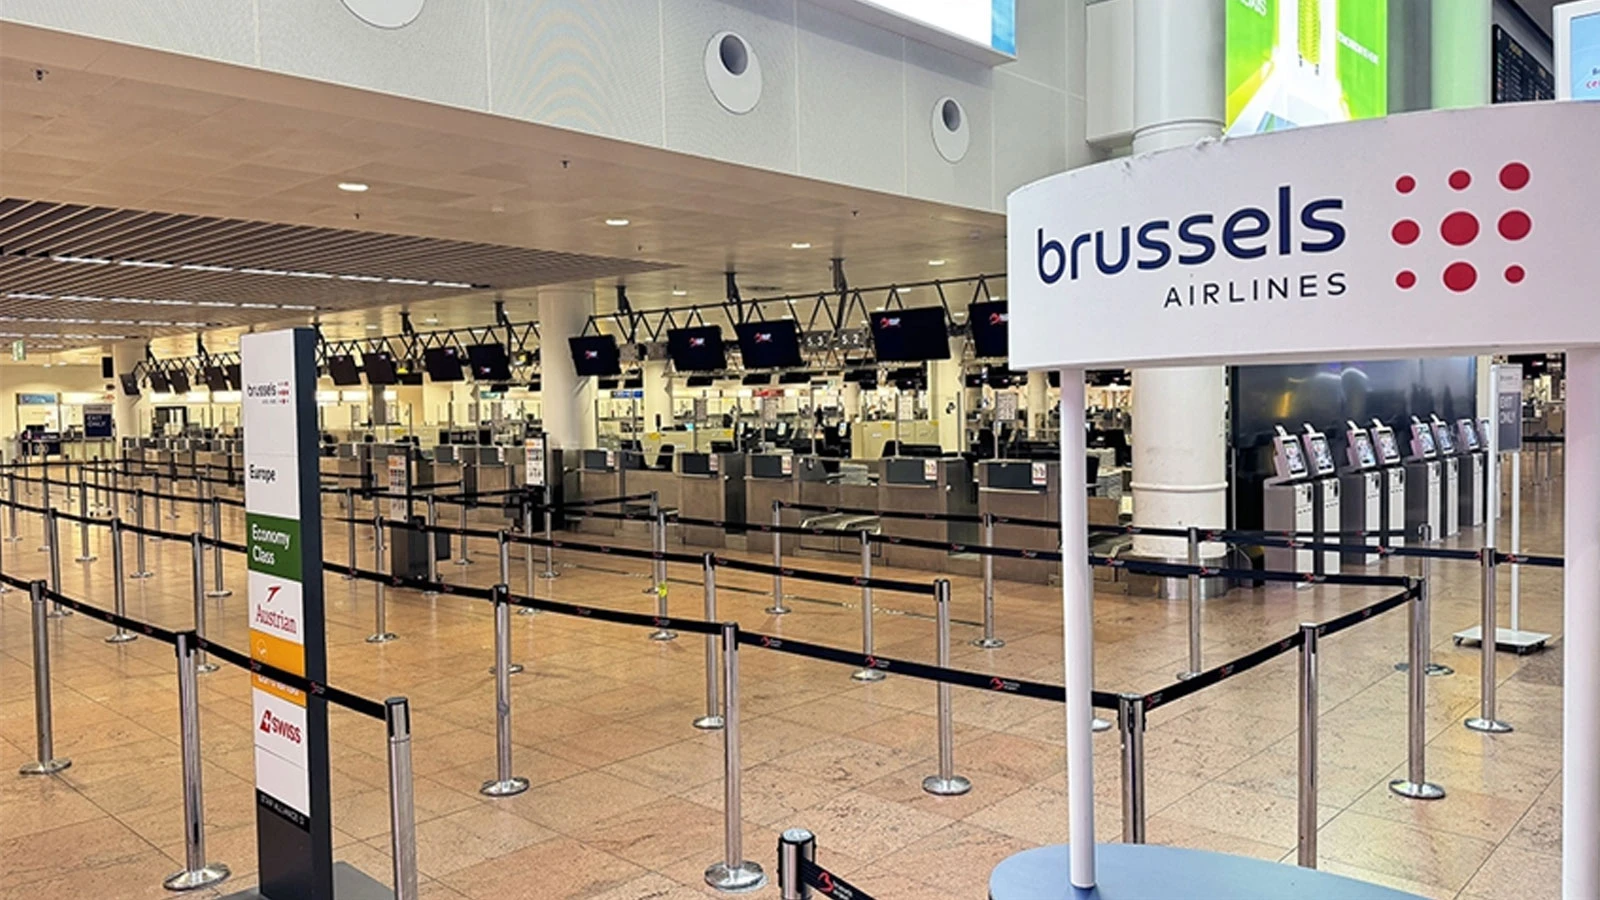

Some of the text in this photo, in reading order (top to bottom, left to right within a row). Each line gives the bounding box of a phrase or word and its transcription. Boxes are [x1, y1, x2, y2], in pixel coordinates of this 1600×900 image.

[1037, 185, 1347, 285] brussels
[1163, 272, 1347, 309] AIRLINES
[250, 464, 276, 483] Europe
[252, 523, 290, 550] Economy
[252, 544, 276, 566] Class
[256, 604, 297, 634] Austrian
[272, 717, 301, 744] SWISS
